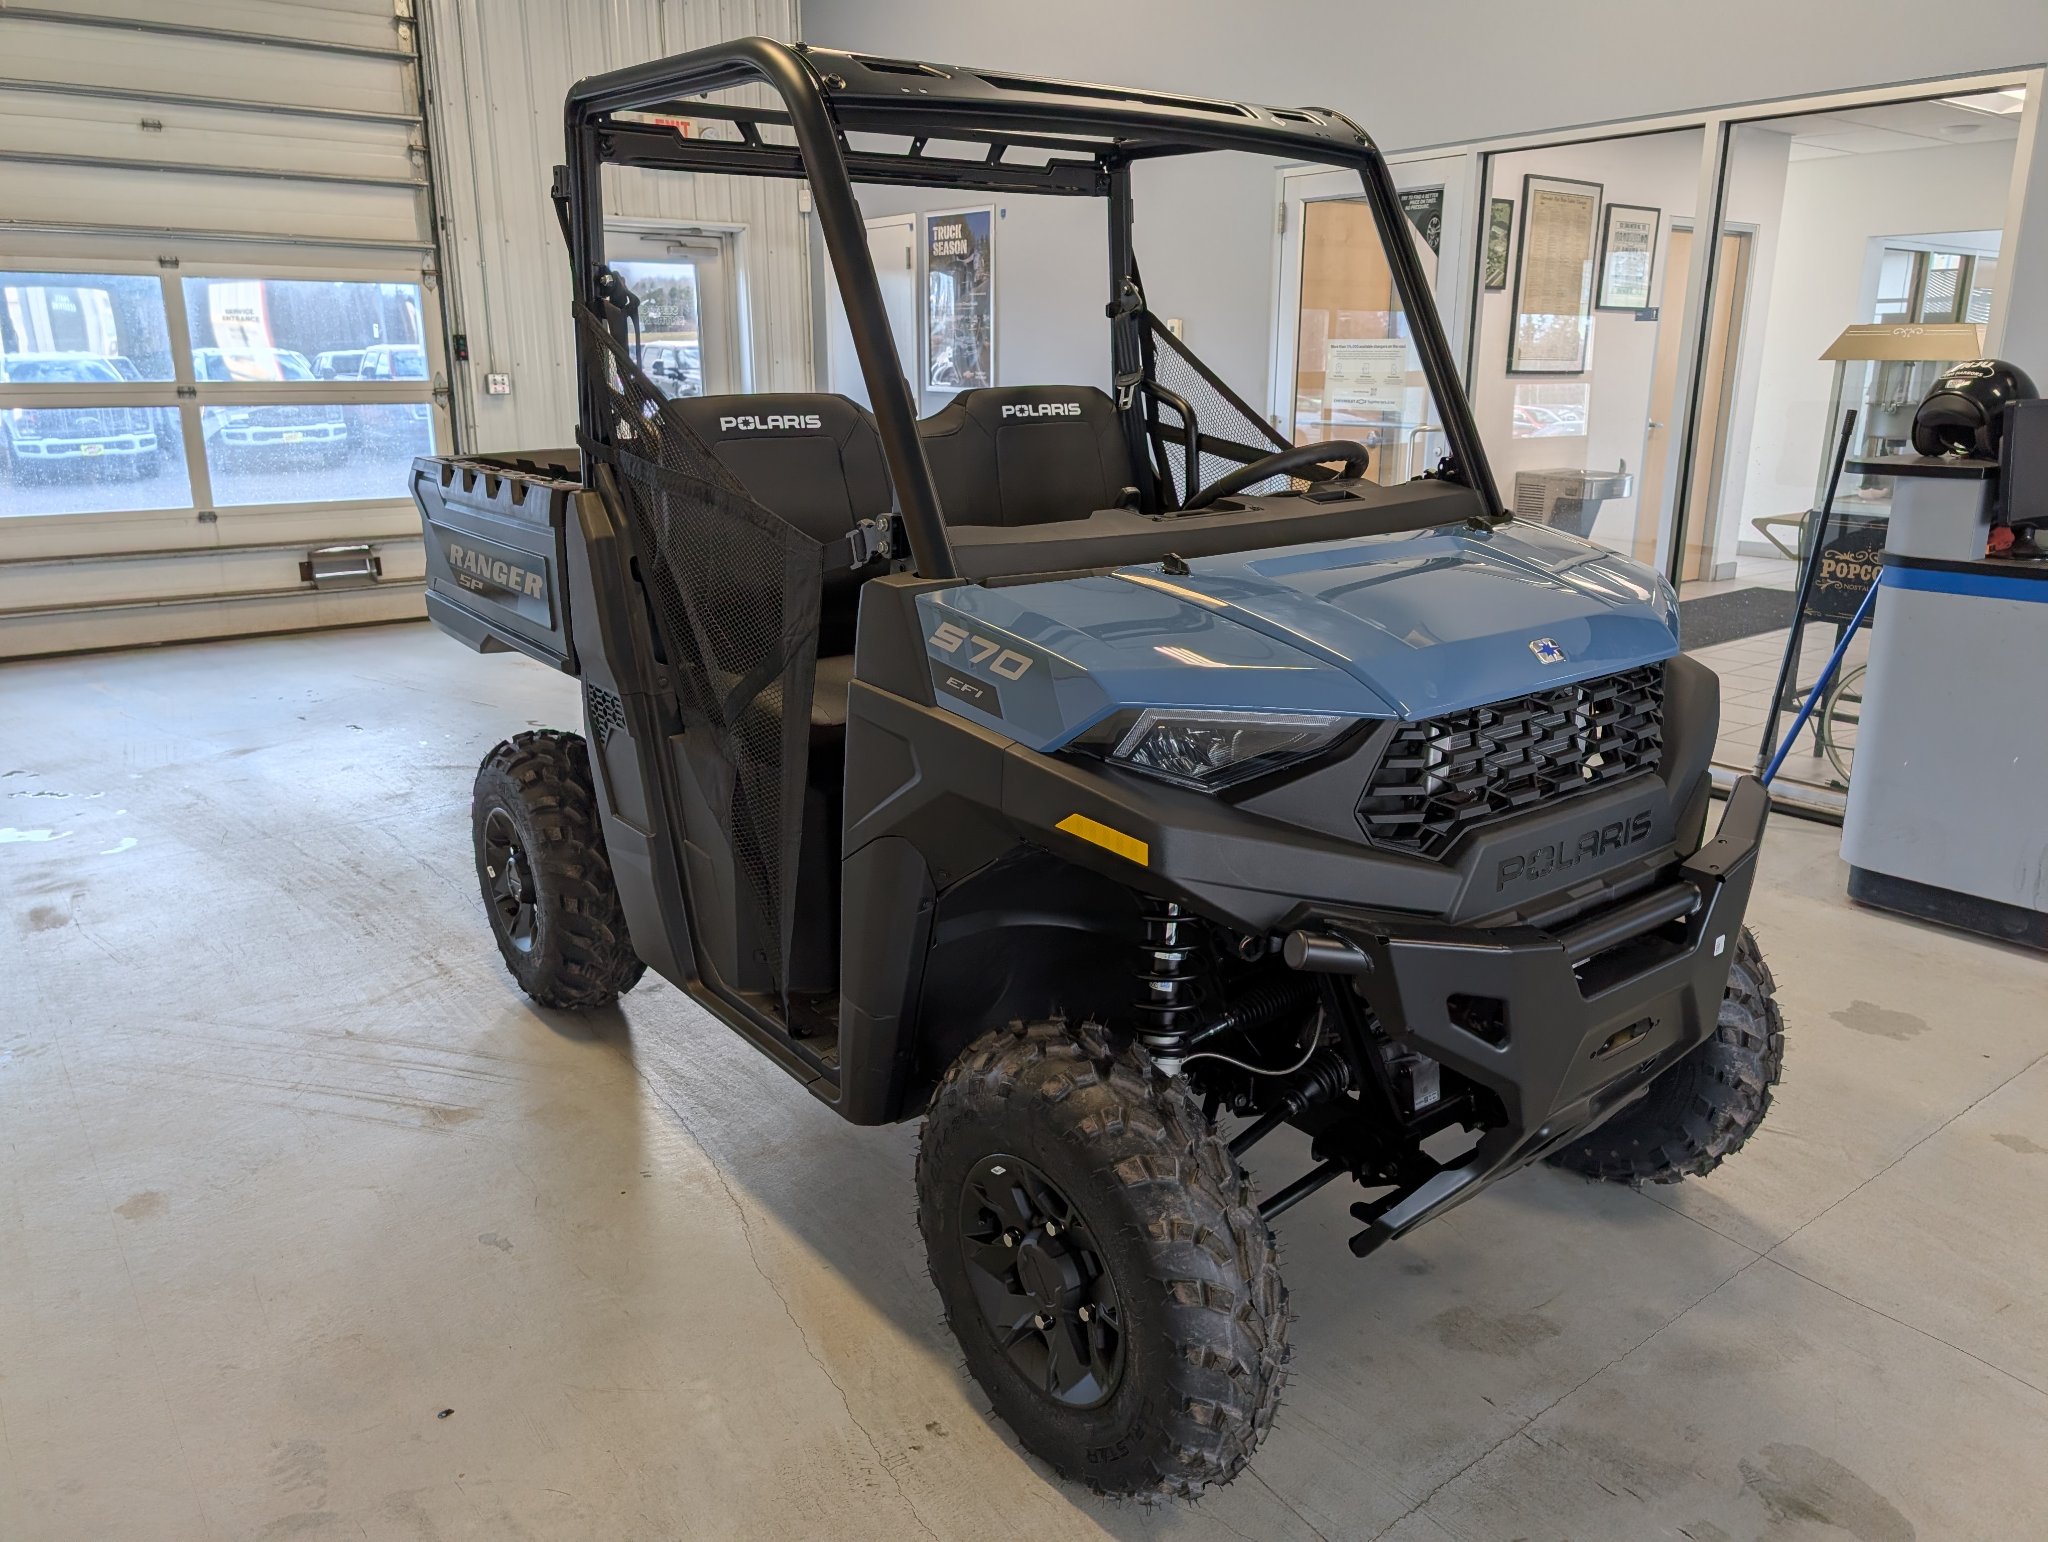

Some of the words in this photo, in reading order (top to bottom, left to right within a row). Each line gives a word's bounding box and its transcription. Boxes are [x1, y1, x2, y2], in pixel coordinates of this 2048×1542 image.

[932, 223, 962, 241] TRUCK
[932, 239, 968, 256] SEASON
[1001, 402, 1082, 418] POLARIS
[720, 414, 822, 431] POLARIS
[449, 543, 544, 600] RANGER
[459, 573, 484, 591] SP
[928, 621, 1034, 681] 570
[946, 676, 984, 698] EFI
[1496, 809, 1653, 893] POLARIS
